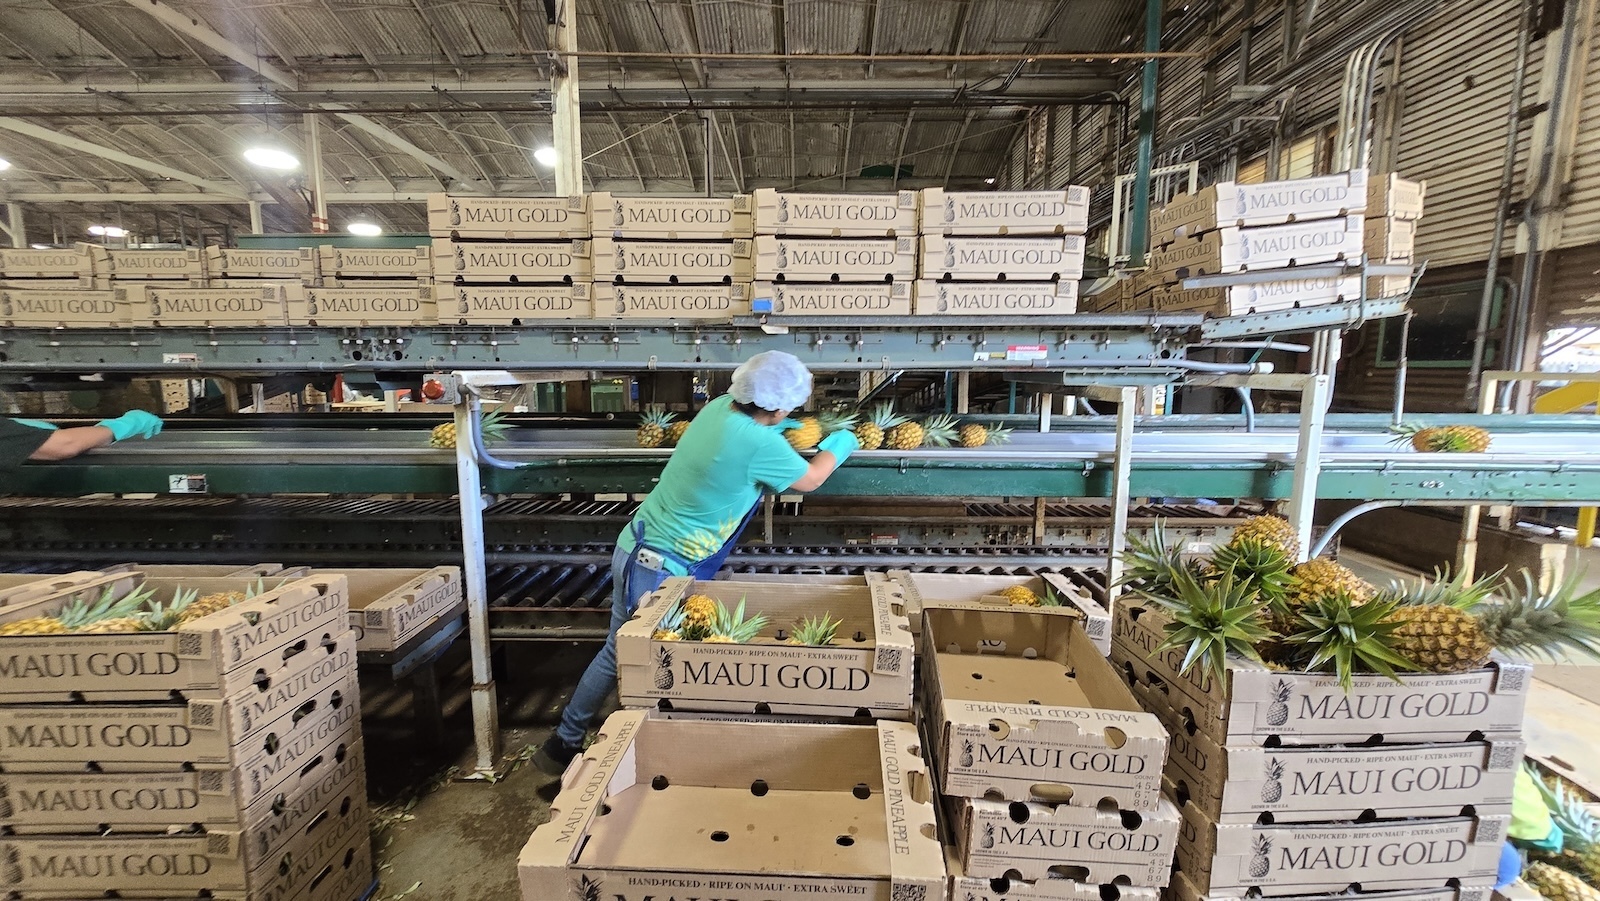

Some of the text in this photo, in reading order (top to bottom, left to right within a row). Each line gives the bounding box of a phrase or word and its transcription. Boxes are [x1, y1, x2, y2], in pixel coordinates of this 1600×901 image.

[1250, 190, 1297, 210] MAUI
[1300, 186, 1348, 204] GOLD
[465, 208, 568, 222] MAUI GOLD
[629, 208, 731, 223] MAUI GOLD
[793, 205, 896, 220] MAUI GOLD
[959, 201, 1065, 218] MAUI GOLD
[1254, 234, 1297, 254] MAUI
[1300, 231, 1345, 250] GOLD
[8, 256, 78, 267] MAUI GOLD
[118, 257, 188, 268] MAUI GOLD
[231, 256, 300, 268] MAUI GOLD
[346, 255, 417, 266] MAUI GOLD
[470, 253, 571, 267] MAUI GOLD
[630, 253, 732, 268] MAUI GOLD
[792, 250, 895, 266] MAUI GOLD
[959, 249, 1062, 265] MAUI GOLD
[16, 299, 116, 314] MAUI GOLD
[165, 298, 263, 313] MAUI GOLD
[321, 298, 419, 312] MAUI GOLD
[473, 296, 572, 310] MAUI GOLD
[630, 296, 730, 310] MAUI GOLD
[788, 294, 890, 310] MAUI GOLD
[952, 294, 1055, 309] MAUI GOLD
[402, 581, 457, 624] MAUI GOLD
[243, 592, 340, 651] MAUI GOLD
[0, 652, 180, 679] MAUI GOLD
[682, 660, 870, 691] MAUI GOLD
[253, 651, 349, 719] MAUI GOLD
[965, 704, 1043, 717] PINEAPPLE
[1296, 691, 1489, 719] MAUI GOLD
[1048, 709, 1090, 719] GOLD
[8, 724, 192, 748] MAUI GOLD
[262, 704, 354, 782] MAUI GOLD
[977, 743, 1145, 774] MAUI GOLD
[555, 720, 636, 843] MAUI GOLD PINEAPPLE
[1290, 765, 1480, 795] MAUI GOLD
[18, 788, 198, 811] MAUI GOLD
[269, 756, 358, 840] MAUI GOLD
[883, 729, 910, 855] MAUI GOLD PINEAPPLE
[1135, 790, 1141, 798] 6
[1434, 826, 1459, 834] SWEET
[998, 826, 1159, 852] MAUI GOLD
[1277, 840, 1467, 870] MAUI GOLD
[29, 854, 210, 877] MAUI GOLD
[628, 878, 701, 888] HAND-PICKED
[709, 881, 733, 889] RIPE
[735, 882, 751, 890] ON
[793, 884, 828, 893] EXTRA
[830, 885, 867, 894] SWEET
